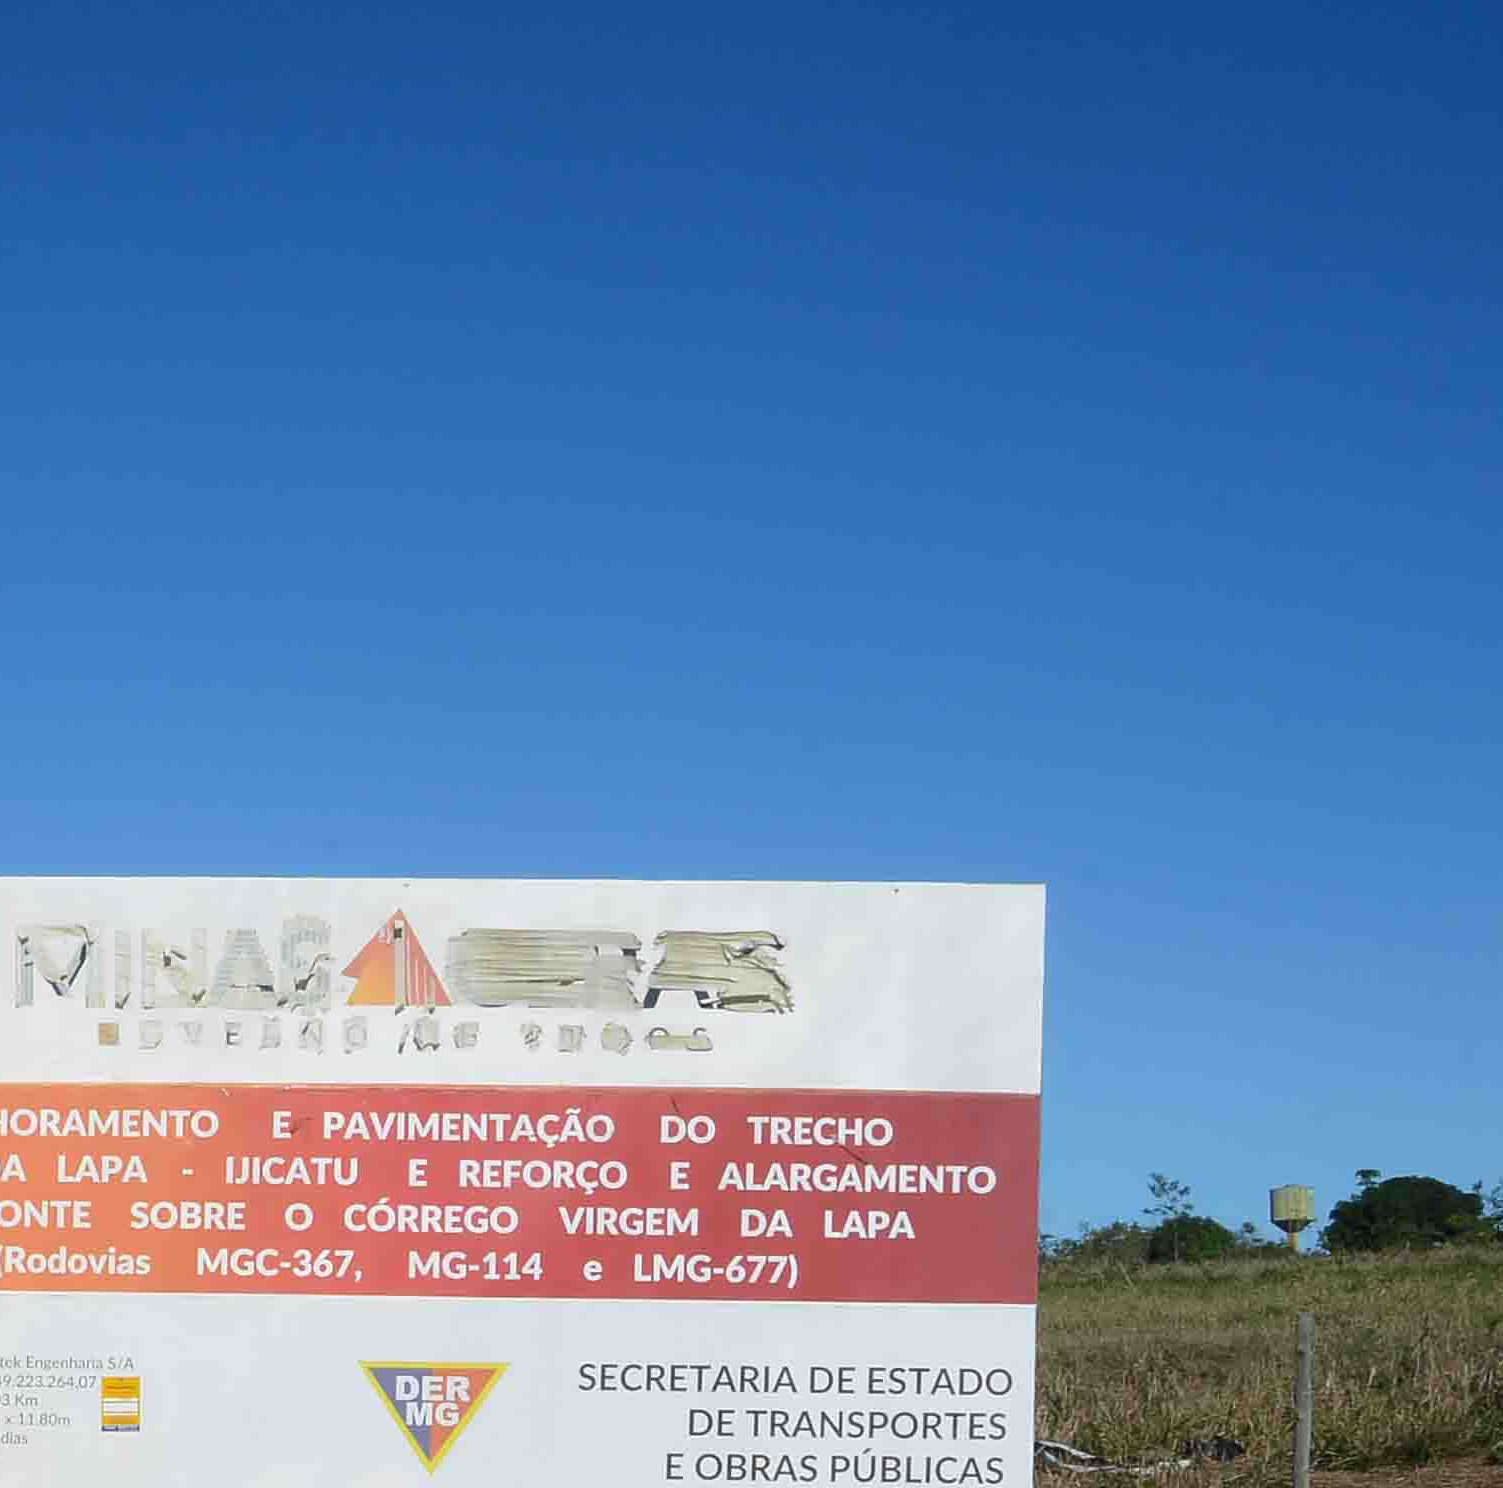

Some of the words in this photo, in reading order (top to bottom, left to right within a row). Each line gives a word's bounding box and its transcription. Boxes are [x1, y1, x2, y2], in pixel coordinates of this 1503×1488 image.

[272, 1110, 292, 1139] E
[322, 1108, 615, 1149] PAVIMENTAÇÃO
[660, 1115, 716, 1144] DO
[747, 1116, 893, 1147] TRECHO
[57, 1154, 148, 1184] LAPA
[225, 1156, 359, 1186] IJICATU
[408, 1158, 428, 1187] E
[459, 1159, 628, 1195] REFORÇO
[670, 1161, 690, 1190] E
[718, 1162, 996, 1194] ALARGAMENTO
[130, 1200, 246, 1231] SOBRE
[284, 1202, 314, 1232] O
[343, 1197, 519, 1234] CÓRREGO
[558, 1206, 699, 1236] VIRGEM
[741, 1208, 793, 1238] DA
[824, 1209, 916, 1239] LAPA
[196, 1247, 362, 1282] MGC-367,
[408, 1250, 543, 1281] MG-114
[583, 1260, 603, 1282] e
[634, 1253, 798, 1289] LMG-677)
[26, 1356, 104, 1371] Engenharia
[107, 1356, 135, 1370] S/A
[578, 1363, 798, 1394] SECRETARIA
[810, 1366, 856, 1395] DE
[868, 1367, 1013, 1396] ESTADO
[15, 1393, 38, 1407] Km
[395, 1375, 471, 1402] DER
[4, 1416, 13, 1425] x
[405, 1401, 460, 1427] MG
[688, 1409, 736, 1437] DE
[747, 1410, 1007, 1441] TRANSPORTES
[0, 1431, 28, 1445] dias
[666, 1453, 684, 1480] E
[695, 1453, 818, 1482] OBRAS
[830, 1449, 1005, 1485] PÚBLICAS
